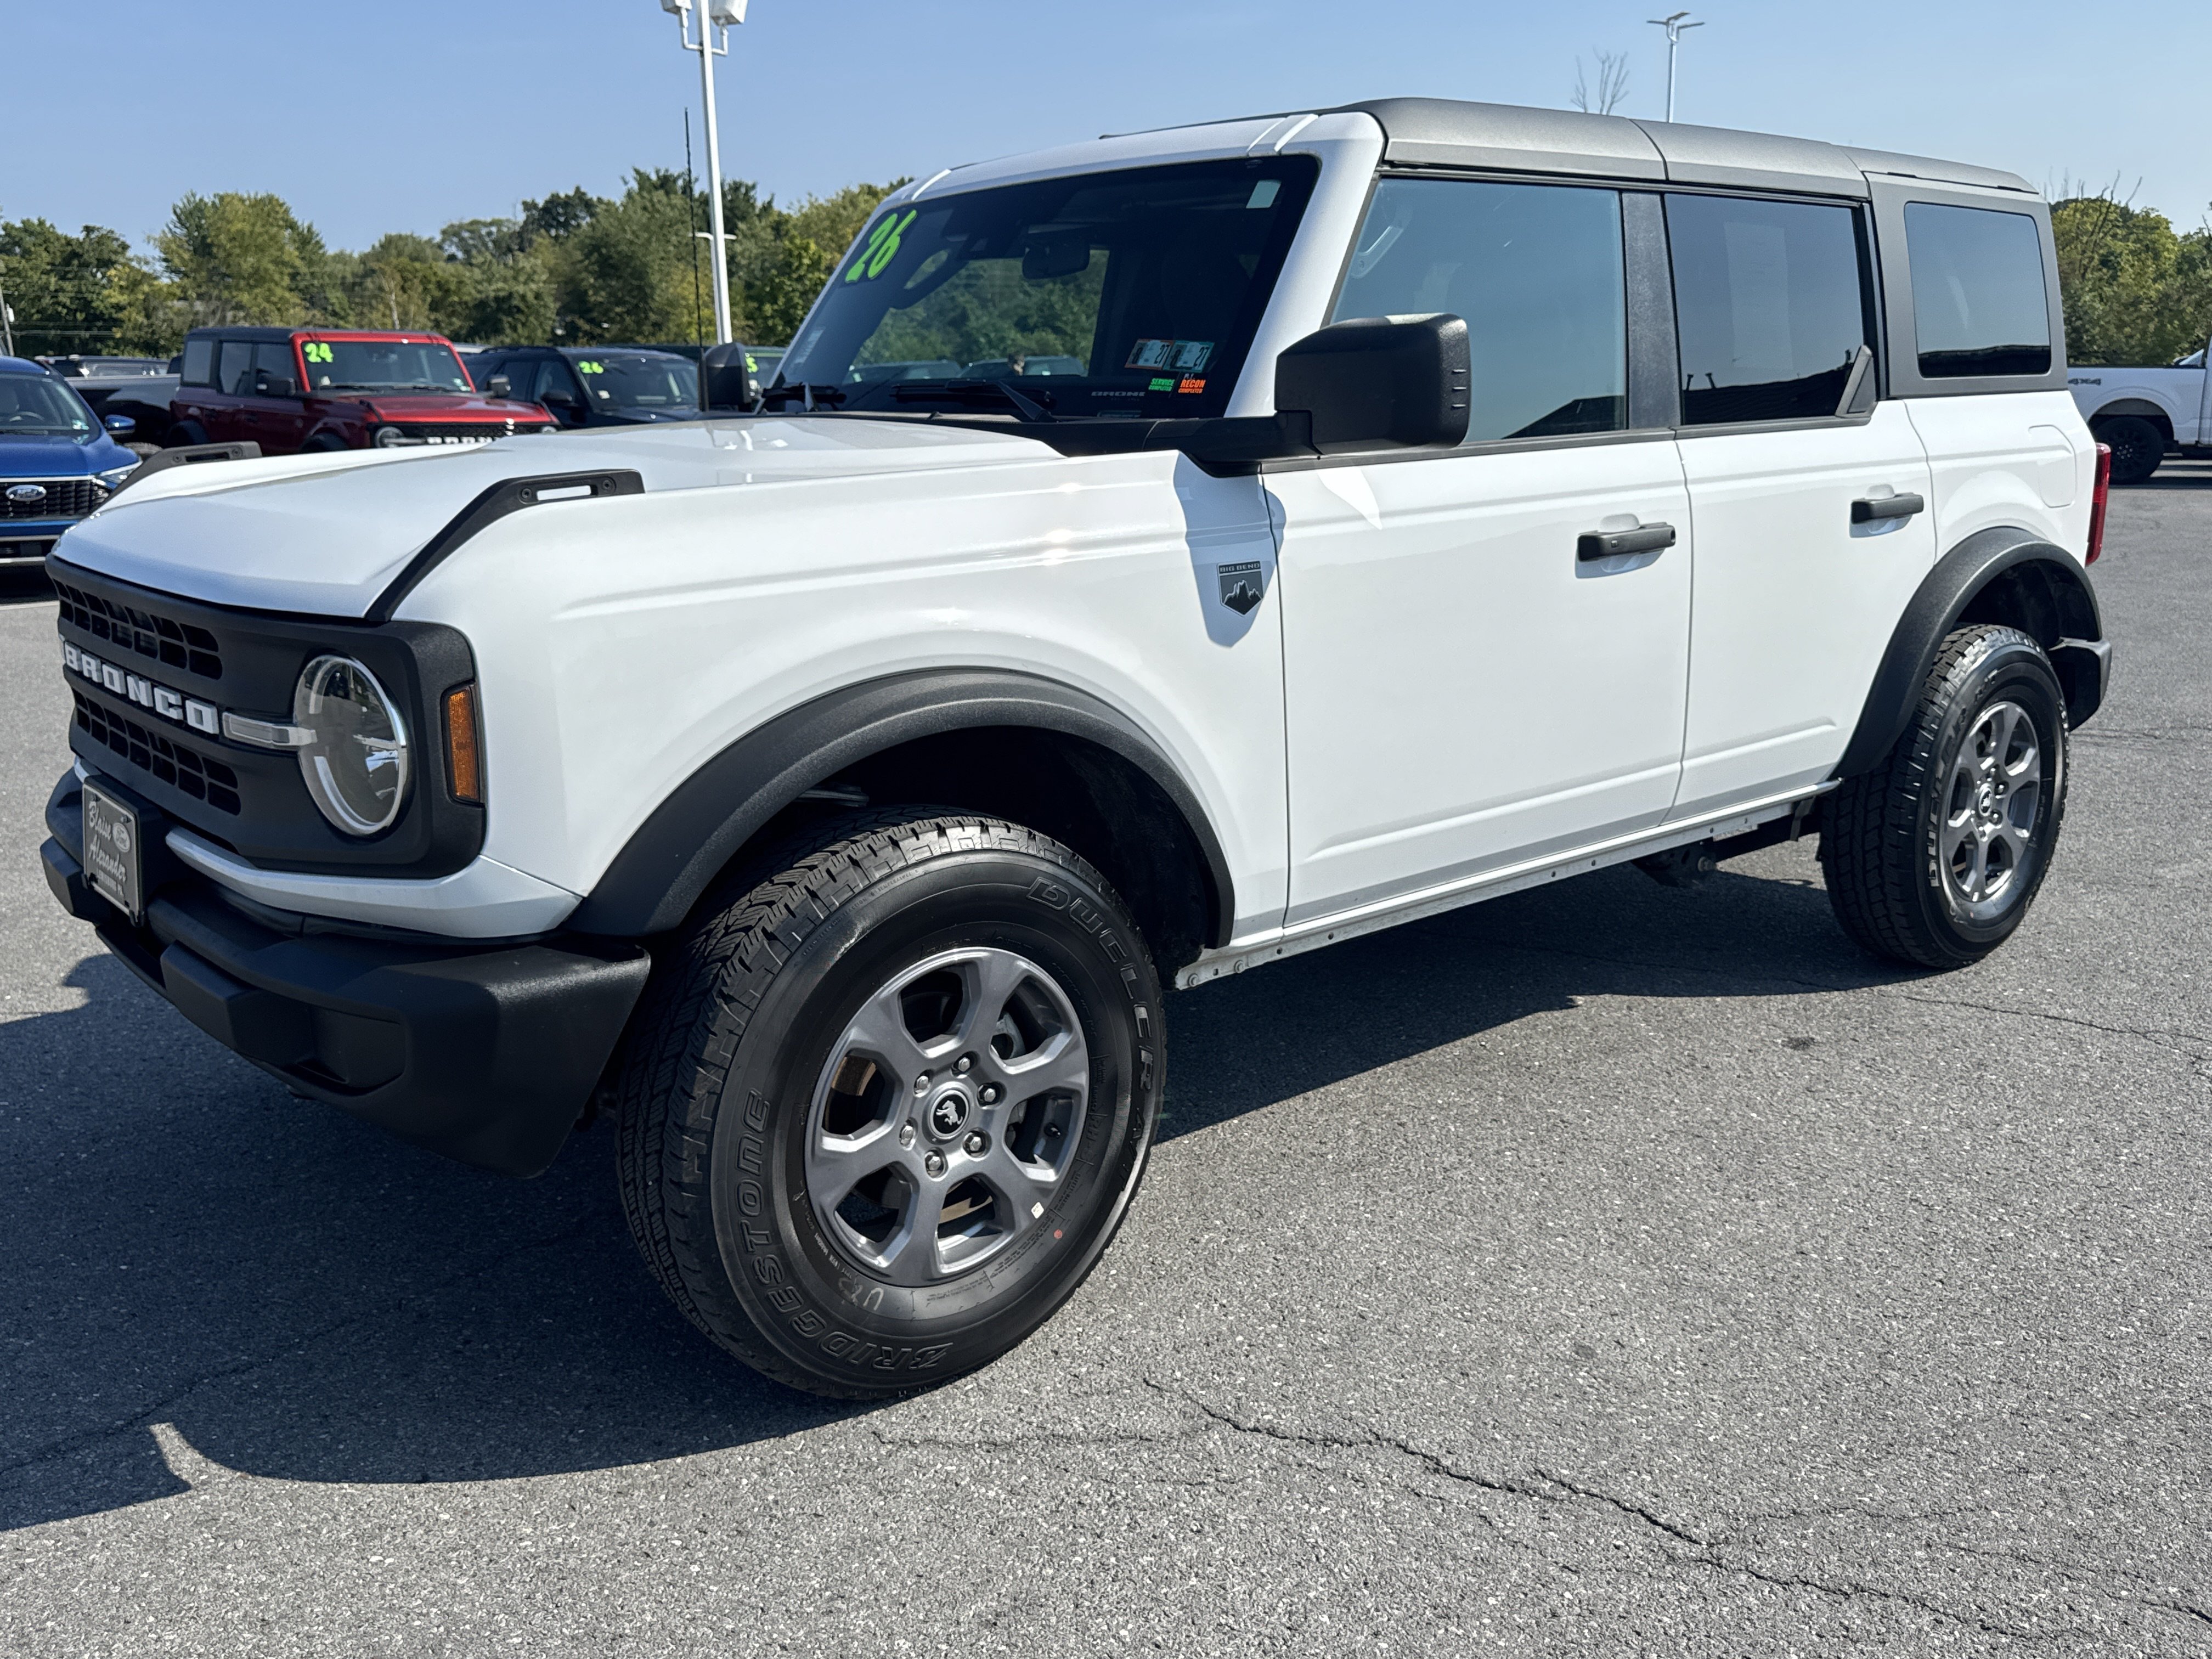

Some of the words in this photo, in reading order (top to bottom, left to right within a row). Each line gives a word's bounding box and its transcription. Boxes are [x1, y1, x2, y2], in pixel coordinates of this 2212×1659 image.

[845, 210, 918, 284] 26
[304, 342, 334, 363] 24
[1153, 344, 1171, 365] 27
[1193, 346, 1210, 369] 27
[1151, 378, 1175, 386] SERVICE
[1180, 379, 1206, 388] RECON
[64, 641, 219, 735] BRONCO
[89, 834, 127, 883] Alexander
[1026, 877, 1154, 1091] DUELER
[737, 1088, 953, 1370] BRIDGESTONE
